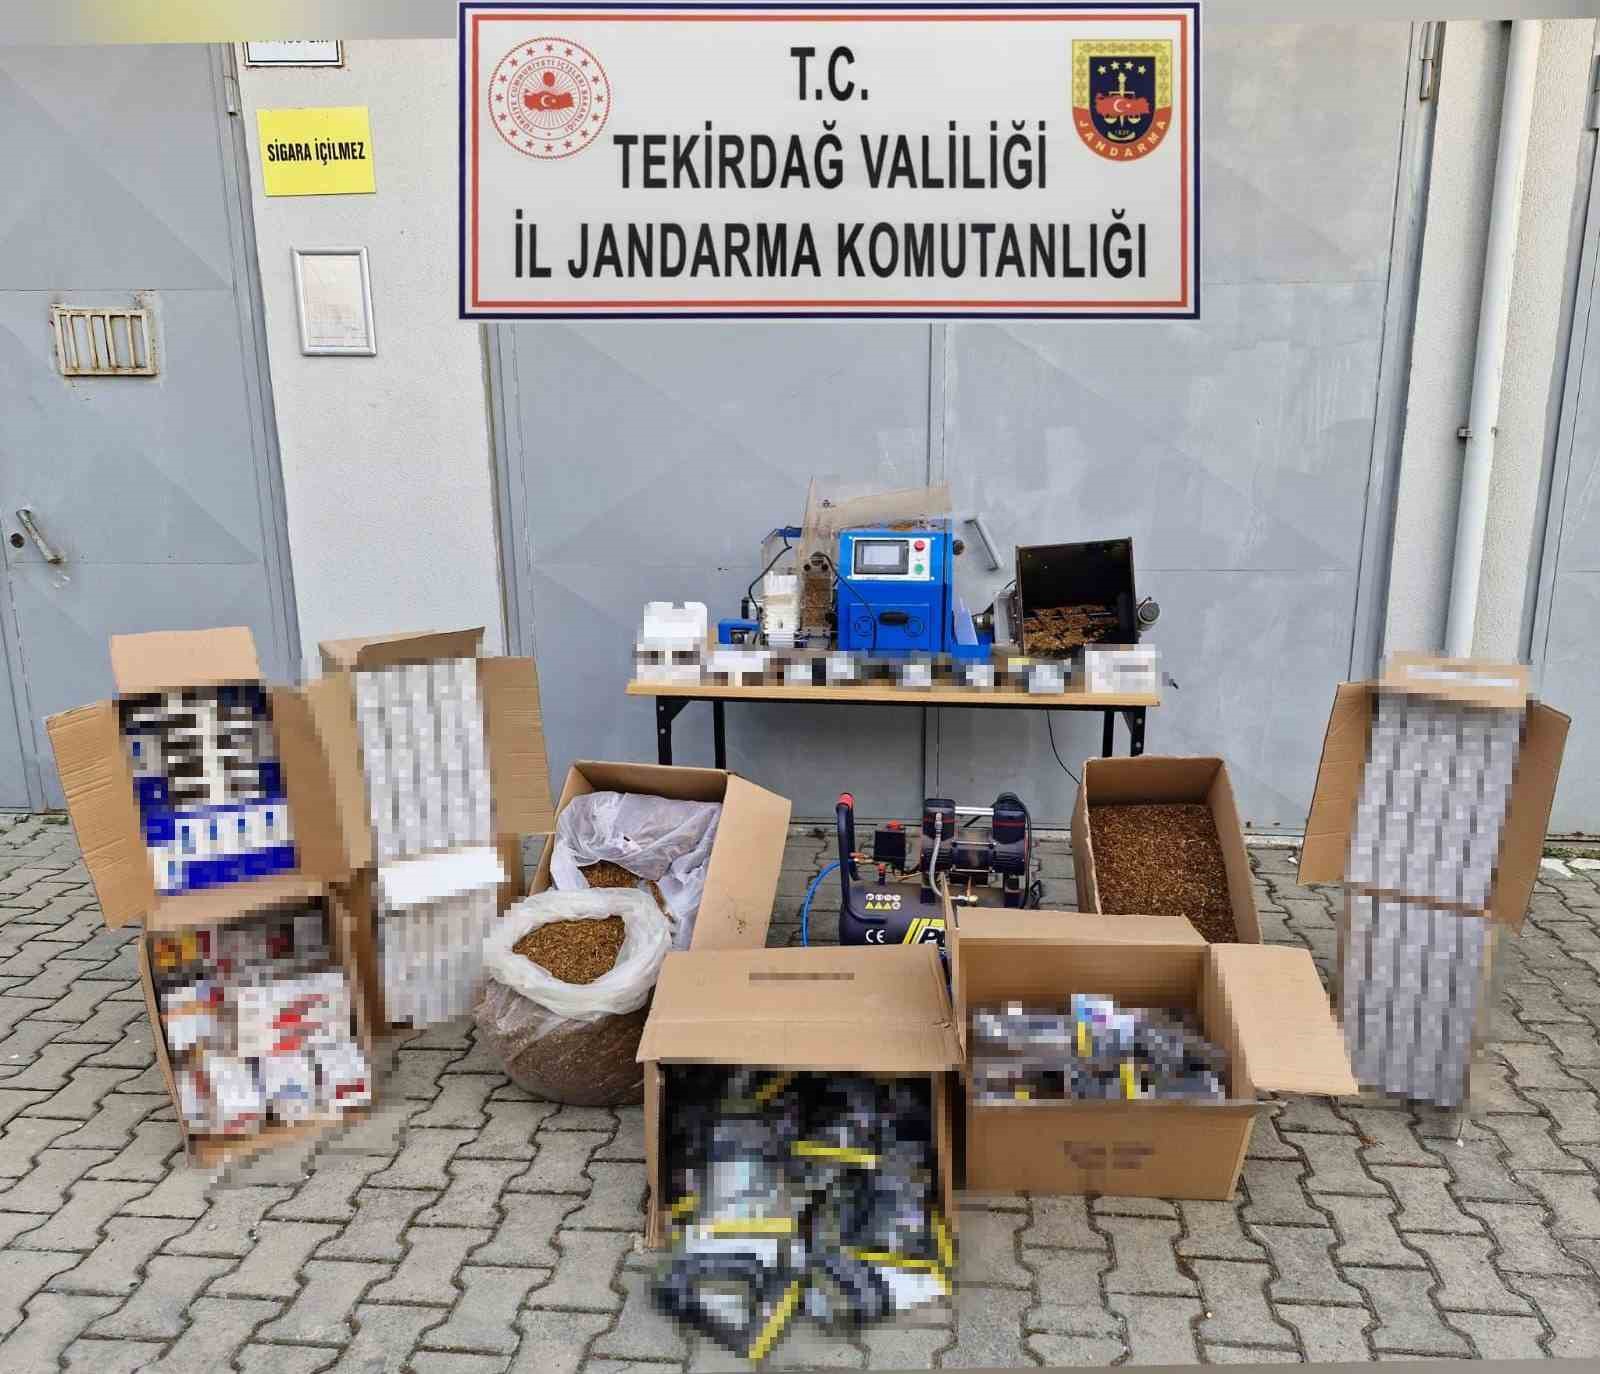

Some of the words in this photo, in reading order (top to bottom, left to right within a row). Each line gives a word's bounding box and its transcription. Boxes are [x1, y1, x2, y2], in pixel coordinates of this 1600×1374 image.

[790, 46, 868, 102] T.C.
[267, 137, 313, 162] SİGARA
[314, 136, 366, 166] İÇİLMEZ
[613, 119, 844, 190] TEKİRDAĞ
[860, 119, 1046, 190] VALİLİĞİ
[1079, 120, 1167, 157] JANDARMA
[515, 208, 552, 278] İL
[567, 222, 822, 279] JANDARMA
[837, 208, 1146, 279] KOMUTANLIĞI
